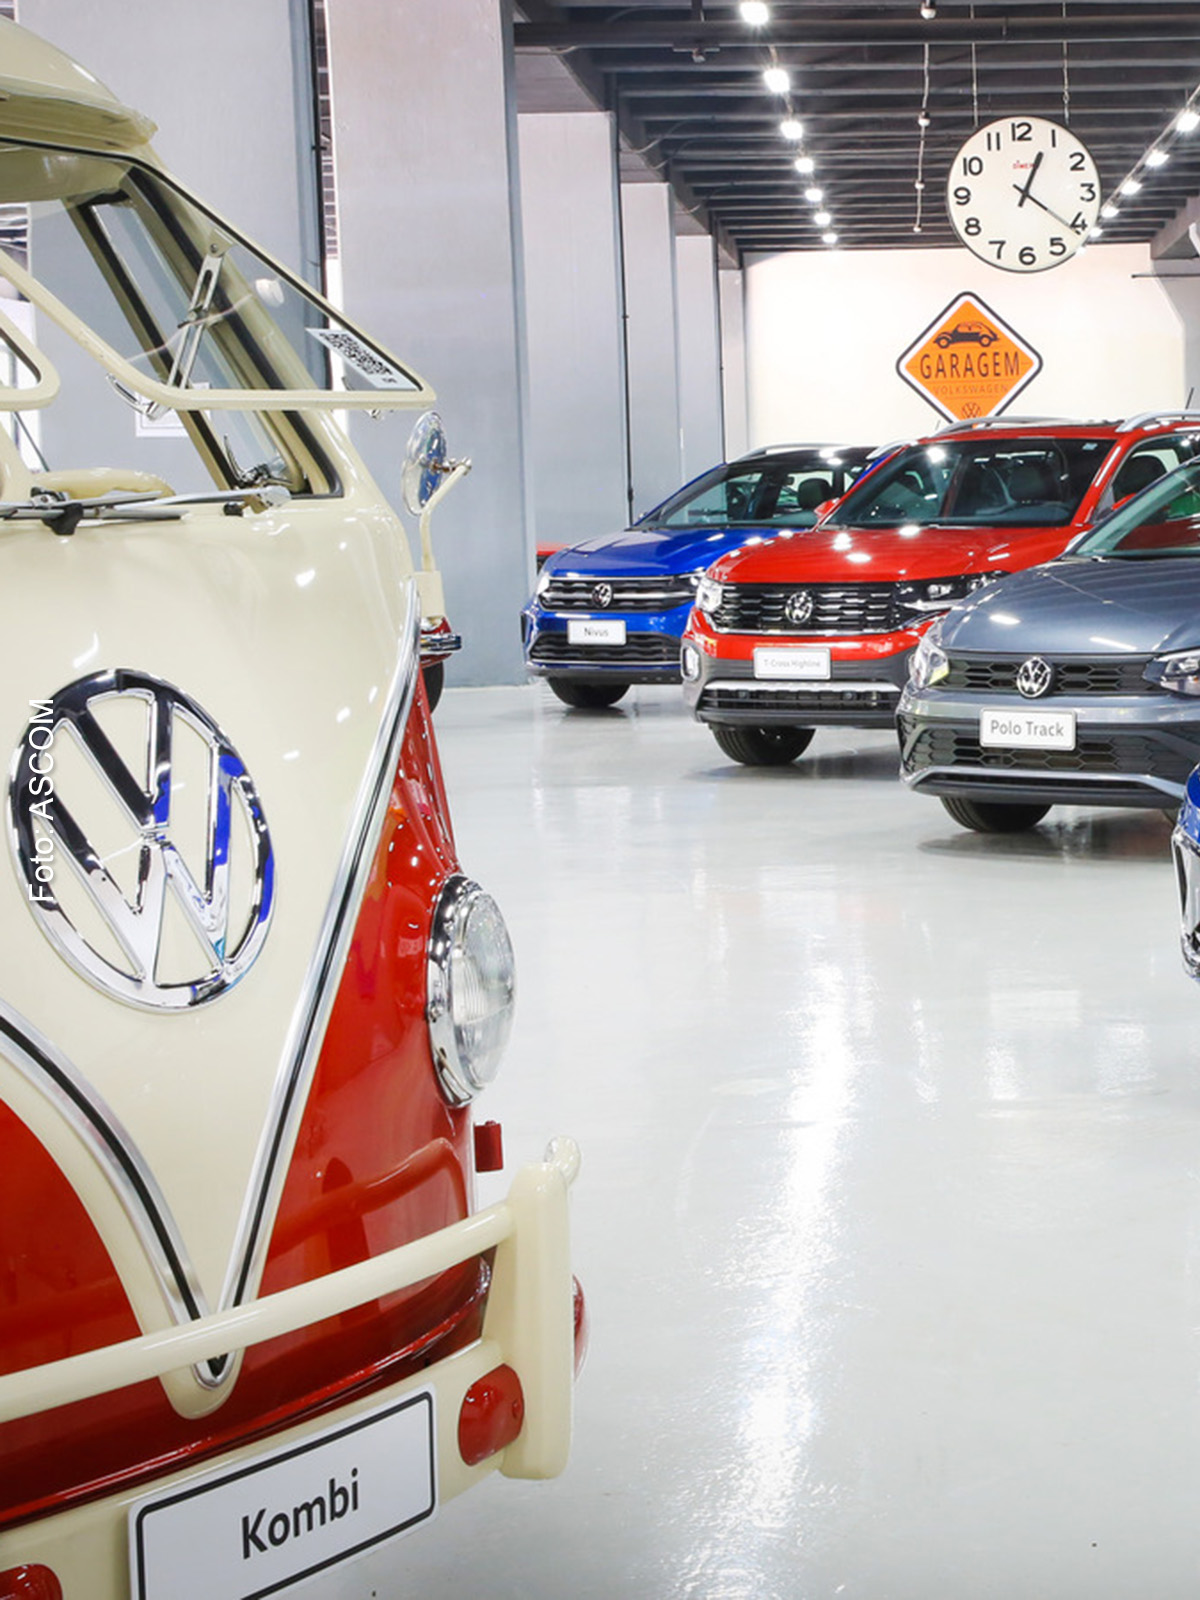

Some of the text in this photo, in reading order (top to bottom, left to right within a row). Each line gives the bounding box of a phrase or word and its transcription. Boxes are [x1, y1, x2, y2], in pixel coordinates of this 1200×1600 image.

[986, 132, 1001, 151] 11
[1011, 122, 1032, 142] 12
[1051, 129, 1057, 148] 1
[963, 157, 983, 176] 10
[1069, 151, 1085, 171] 2
[953, 186, 972, 206] 9
[1080, 182, 1096, 202] 3
[965, 217, 982, 236] 8
[1070, 211, 1088, 231] 4
[989, 240, 1007, 260] 7
[1018, 246, 1037, 266] 6
[1049, 237, 1067, 257] 5
[920, 351, 1020, 380] GARAGEM
[932, 384, 1008, 395] VOLKSWAGEN
[584, 627, 609, 638] Nivus
[763, 659, 821, 670] T-Cross Highline
[990, 719, 1065, 737] Polo Track
[241, 1468, 359, 1560] Kombi
